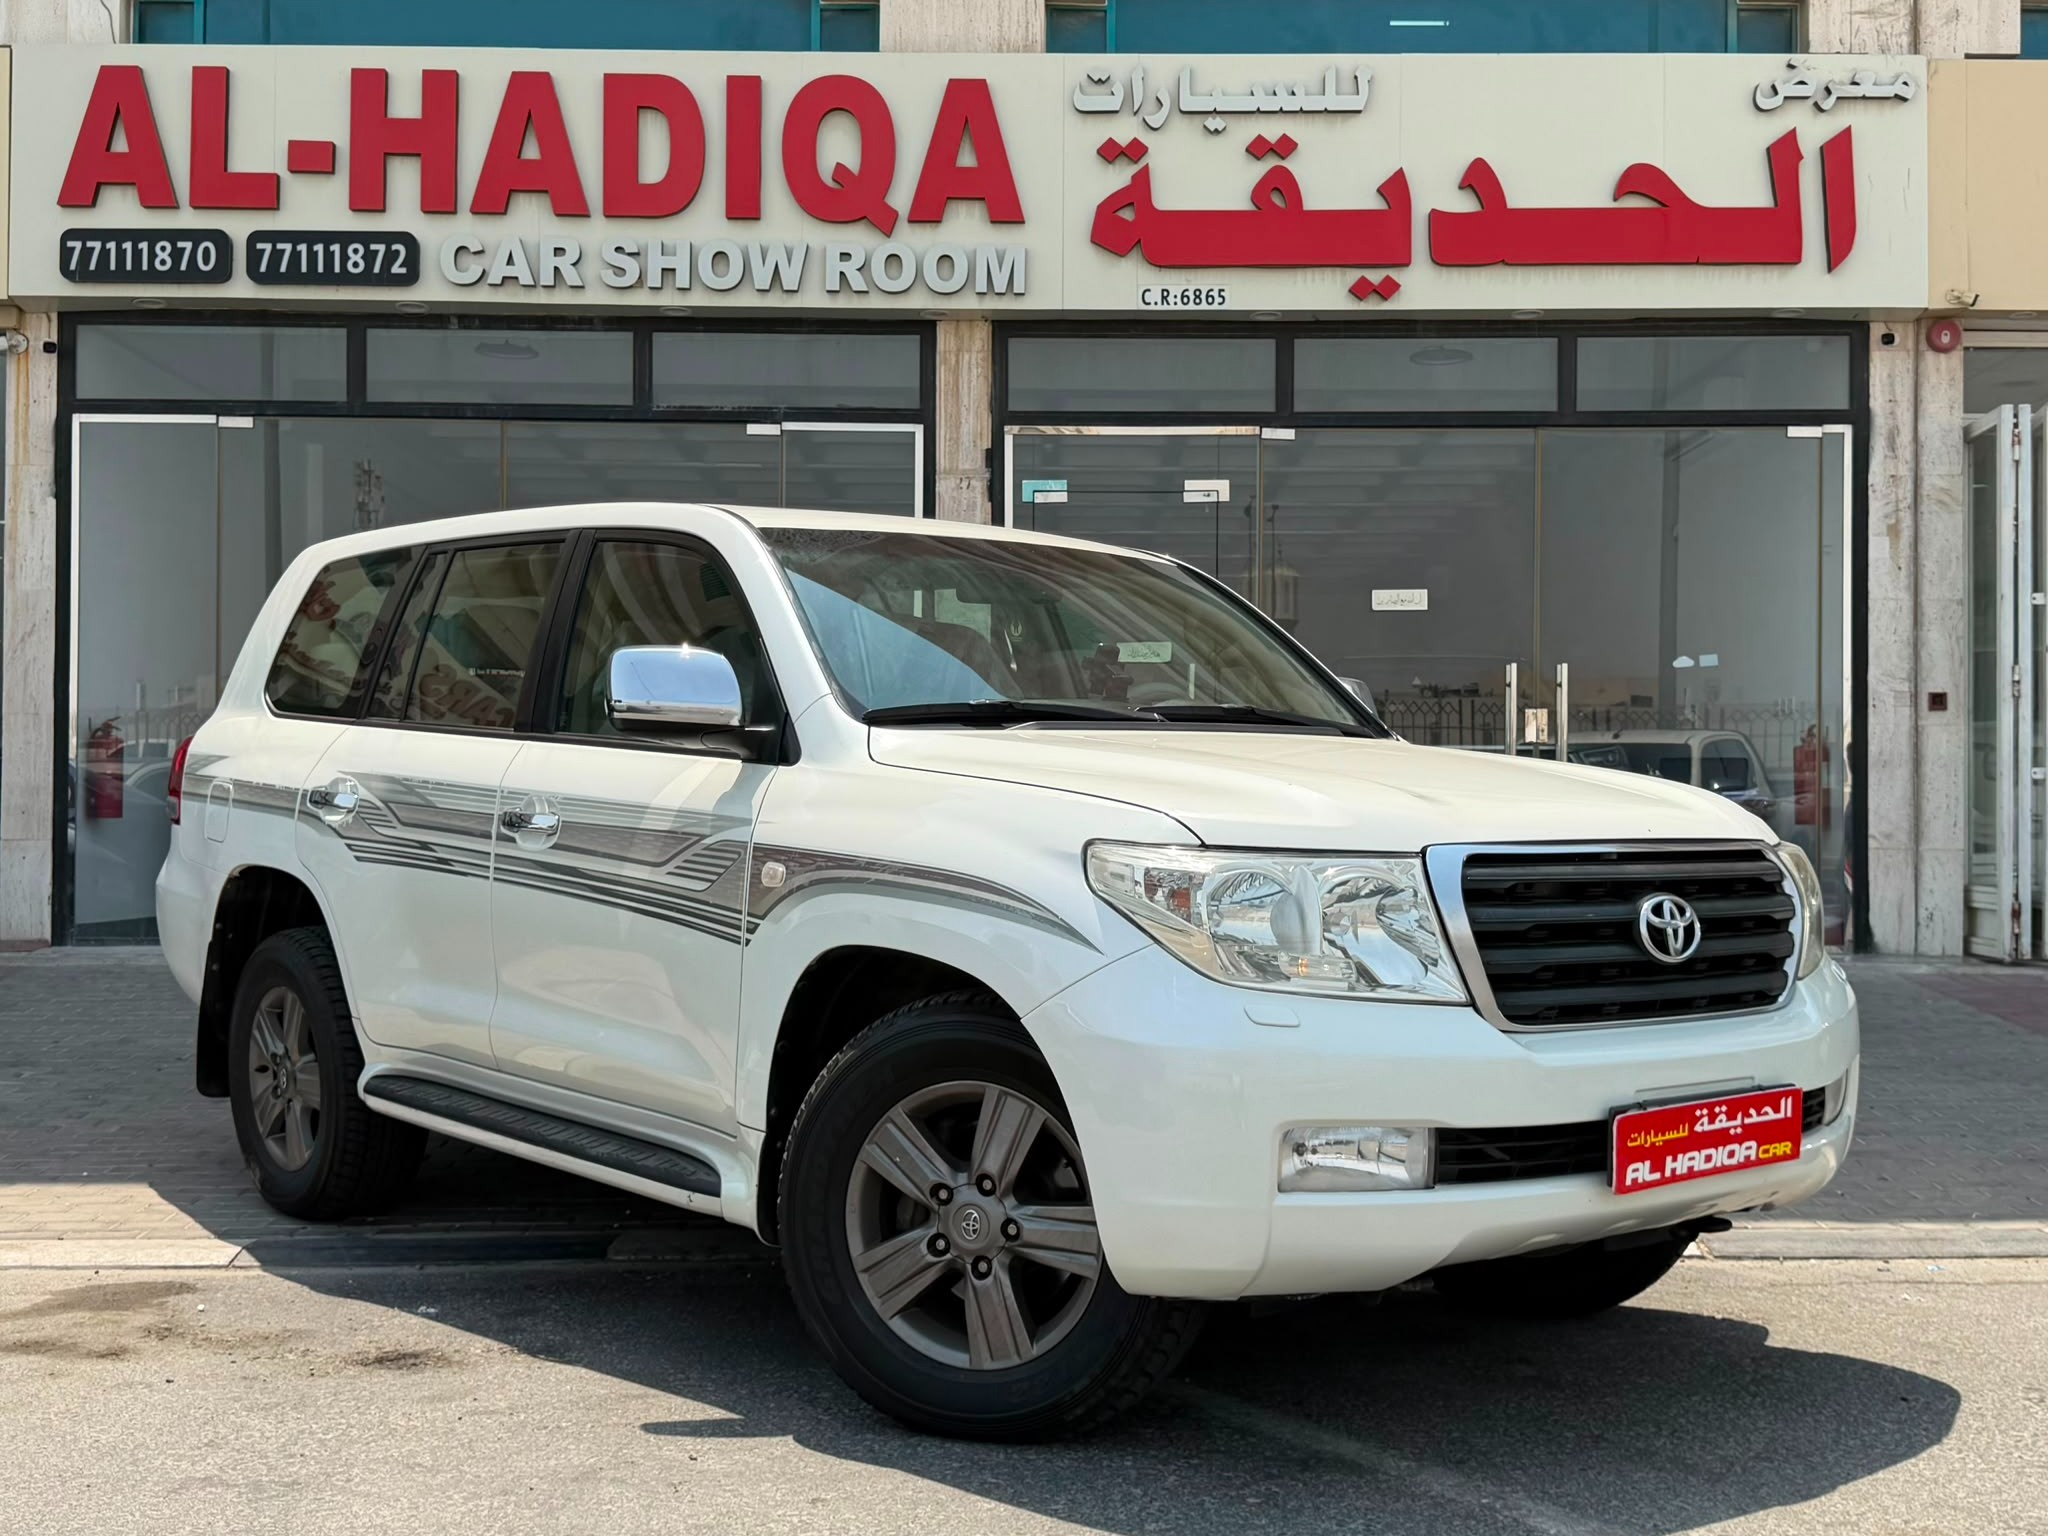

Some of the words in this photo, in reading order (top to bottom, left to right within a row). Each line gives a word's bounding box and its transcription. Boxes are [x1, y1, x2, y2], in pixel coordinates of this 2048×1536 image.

[1072, 65, 1373, 135] للسيارات
[1753, 58, 1917, 113] معرض
[57, 65, 1026, 237] AL-HADIQA
[1090, 125, 1858, 300] الحديقة
[66, 241, 217, 272] 77111870
[255, 242, 408, 274] 77111872
[440, 234, 586, 288] CAR
[600, 237, 809, 291] SHOW
[824, 241, 1026, 296] ROOM
[1141, 288, 1227, 306] C.R:6865
[1626, 1122, 1690, 1148] للسيارات
[1693, 1095, 1793, 1136] الحديقة
[1625, 1160, 1662, 1187] AL
[1664, 1140, 1758, 1178] HADIQA
[1758, 1141, 1793, 1160] CAR
